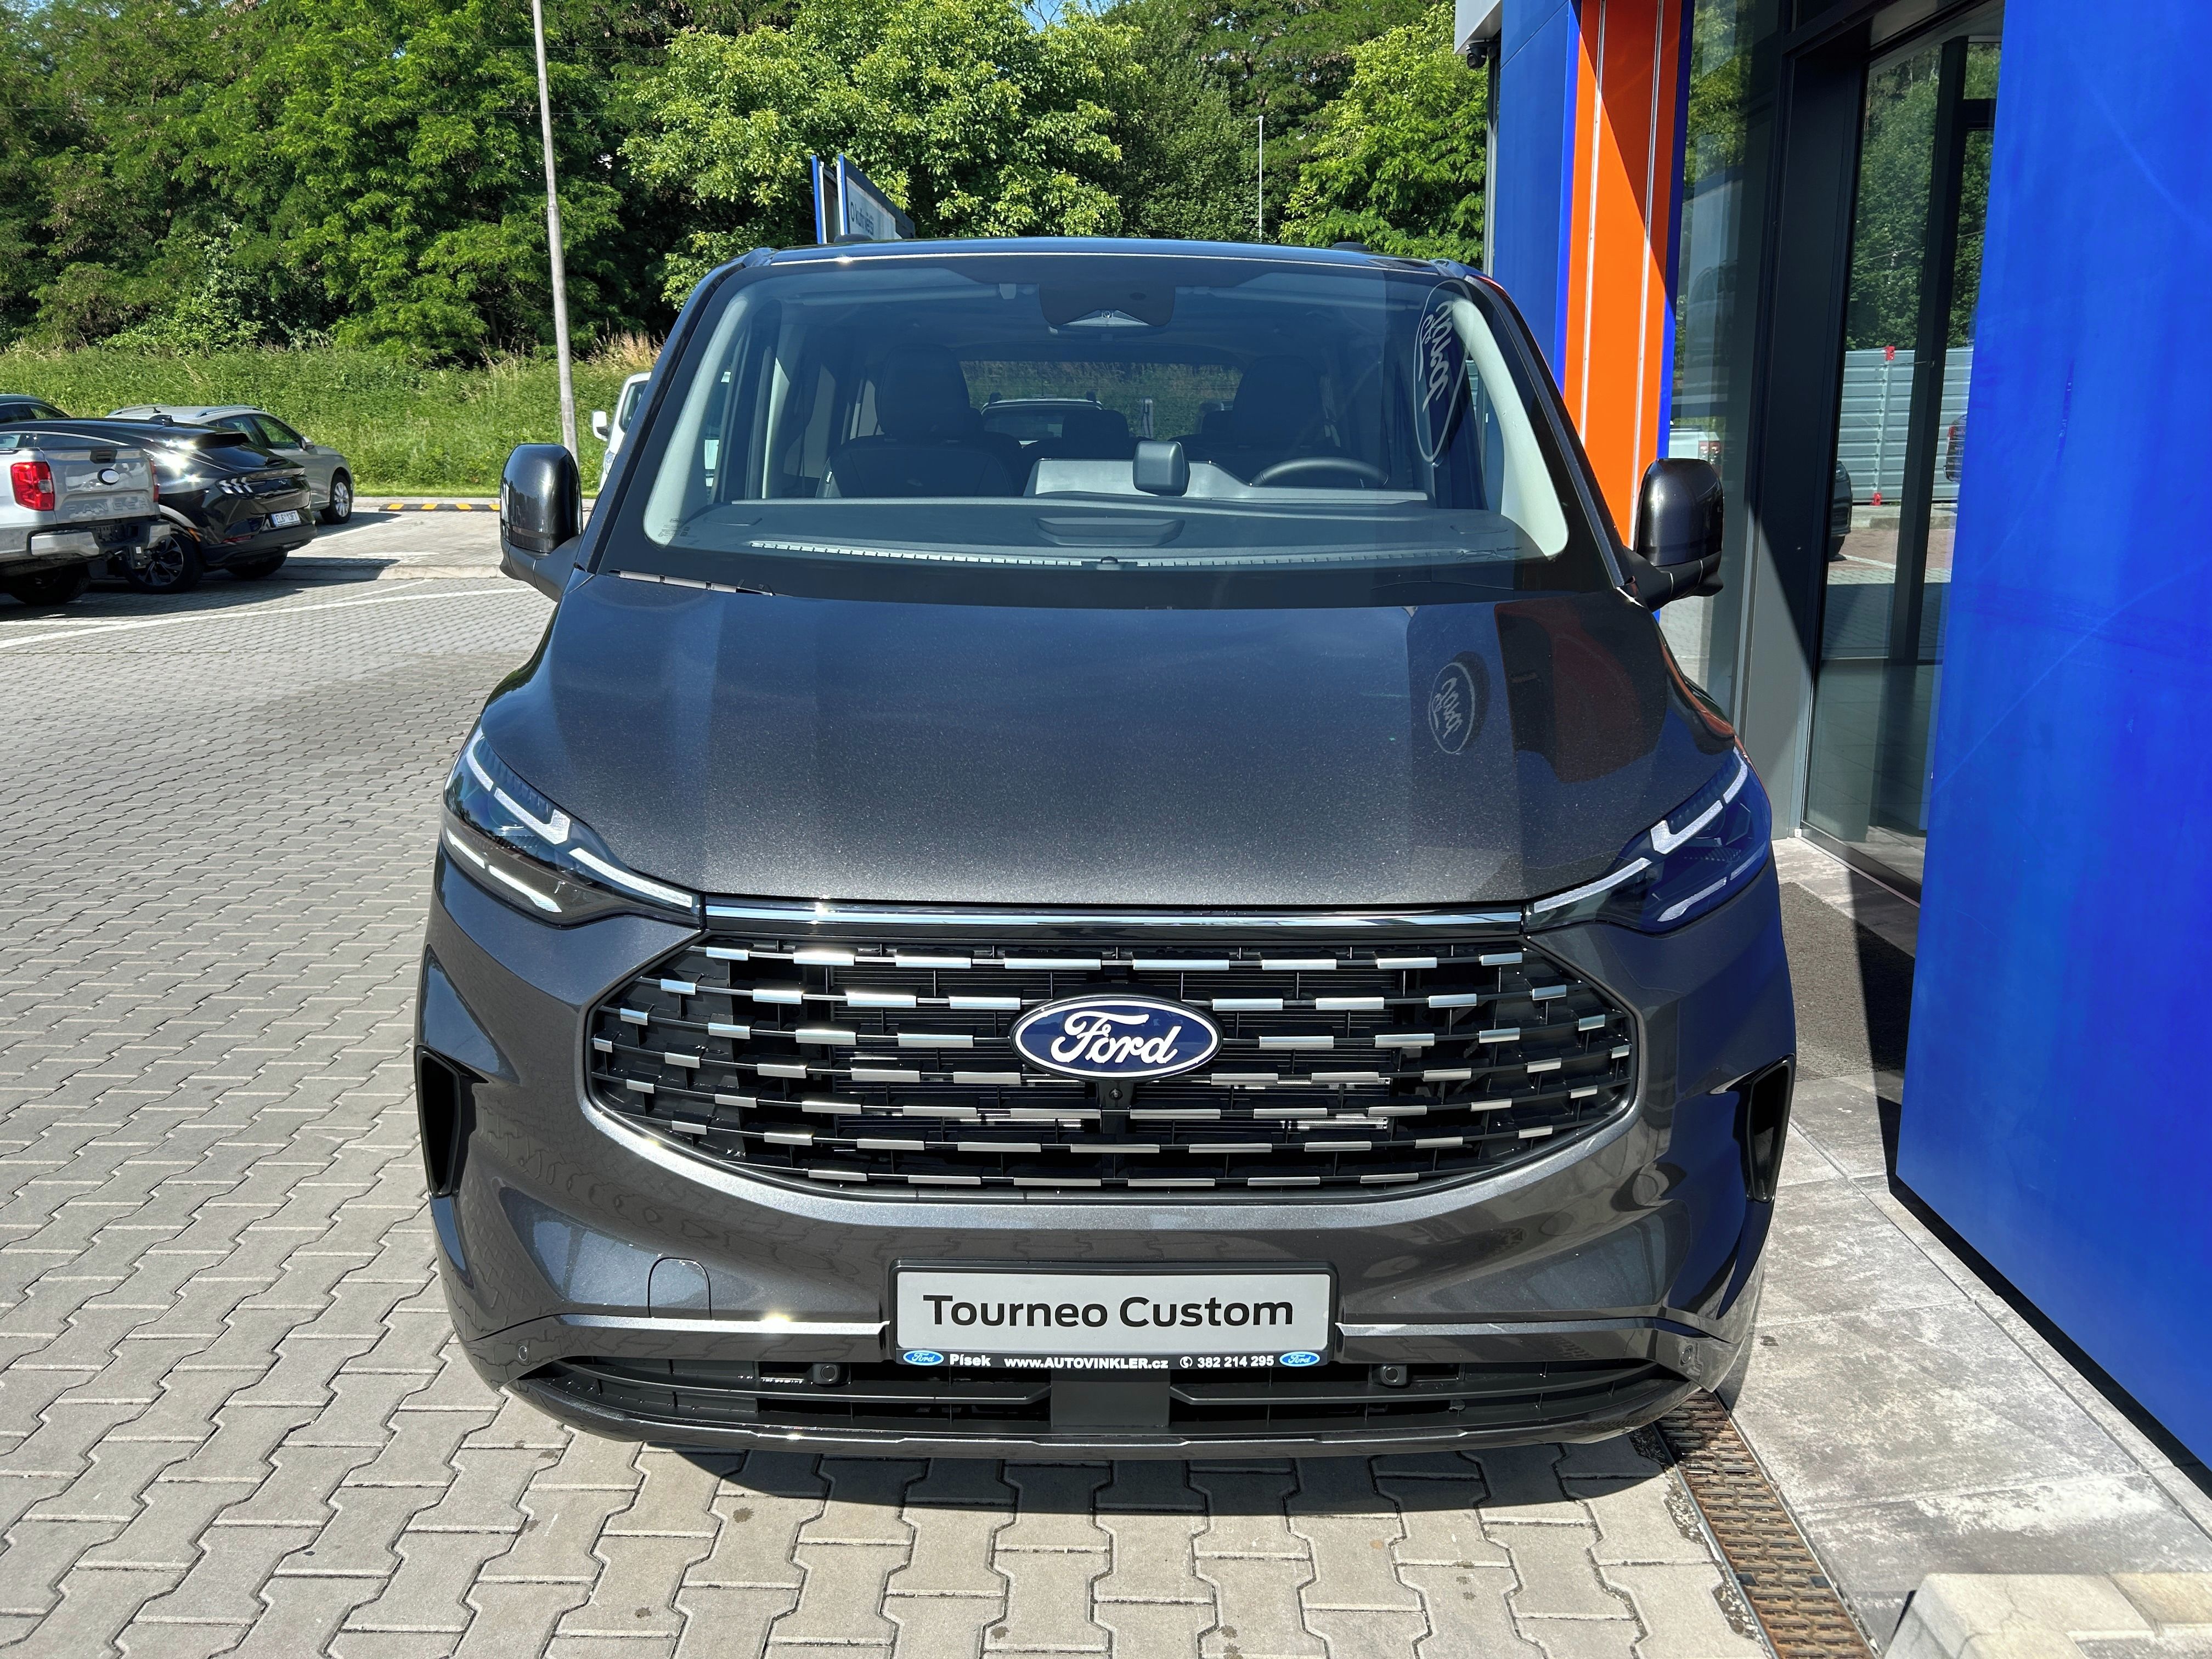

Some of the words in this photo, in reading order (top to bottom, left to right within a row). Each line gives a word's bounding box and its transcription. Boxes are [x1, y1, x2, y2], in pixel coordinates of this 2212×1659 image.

[1051, 1011, 1182, 1064] Ford
[923, 1295, 1108, 1328] Tourneo
[1120, 1296, 1293, 1328] Custom
[950, 1353, 991, 1367] Písek
[1004, 1356, 1169, 1369] www.AUTOVINKLER.cz
[1197, 1357, 1221, 1368] 382
[1224, 1356, 1248, 1367] 214
[1251, 1355, 1274, 1367] 295
